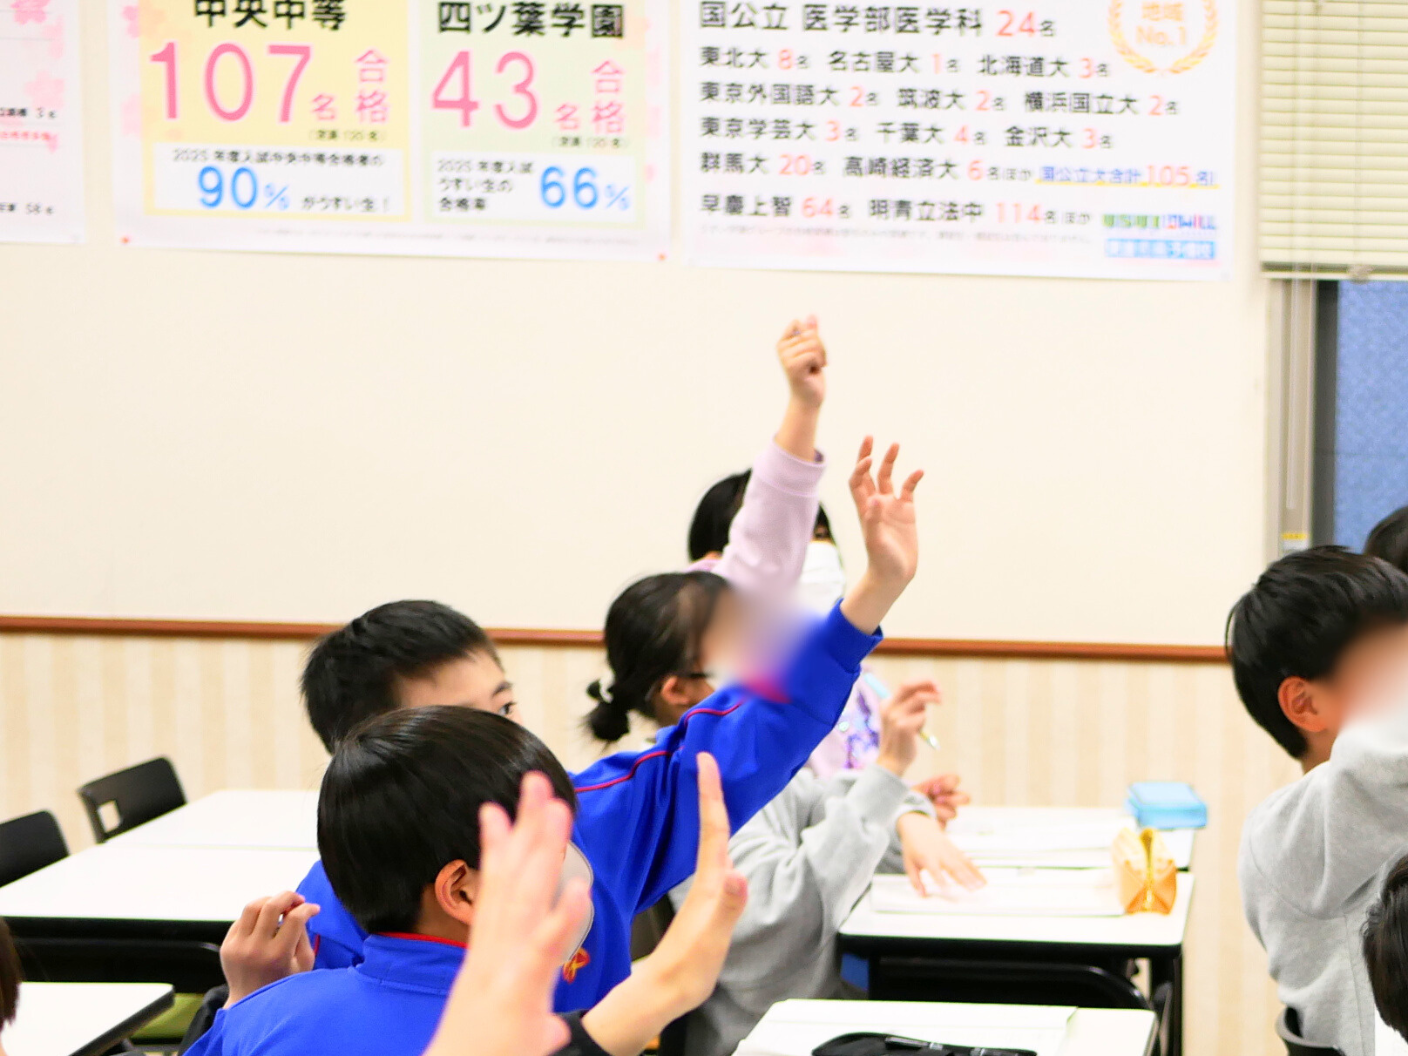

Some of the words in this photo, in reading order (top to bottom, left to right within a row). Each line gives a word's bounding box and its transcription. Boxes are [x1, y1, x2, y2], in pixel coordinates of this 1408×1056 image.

[194, 0, 346, 31] 中央中等
[439, 2, 625, 39] 四ツ葉学園
[700, 1, 788, 31] 国公立
[803, 4, 981, 37] 医学部医学科
[700, 46, 769, 69] 東北大
[828, 50, 920, 74] 名古屋大
[978, 55, 1069, 78] 北海道大
[700, 82, 840, 106] 東京外国語大
[1024, 92, 1139, 116] 横浜国立大
[700, 117, 816, 140] 東京学芸大
[877, 122, 945, 143] 千葉大
[1005, 126, 1072, 148] 金沢大
[700, 152, 769, 175] 群馬大
